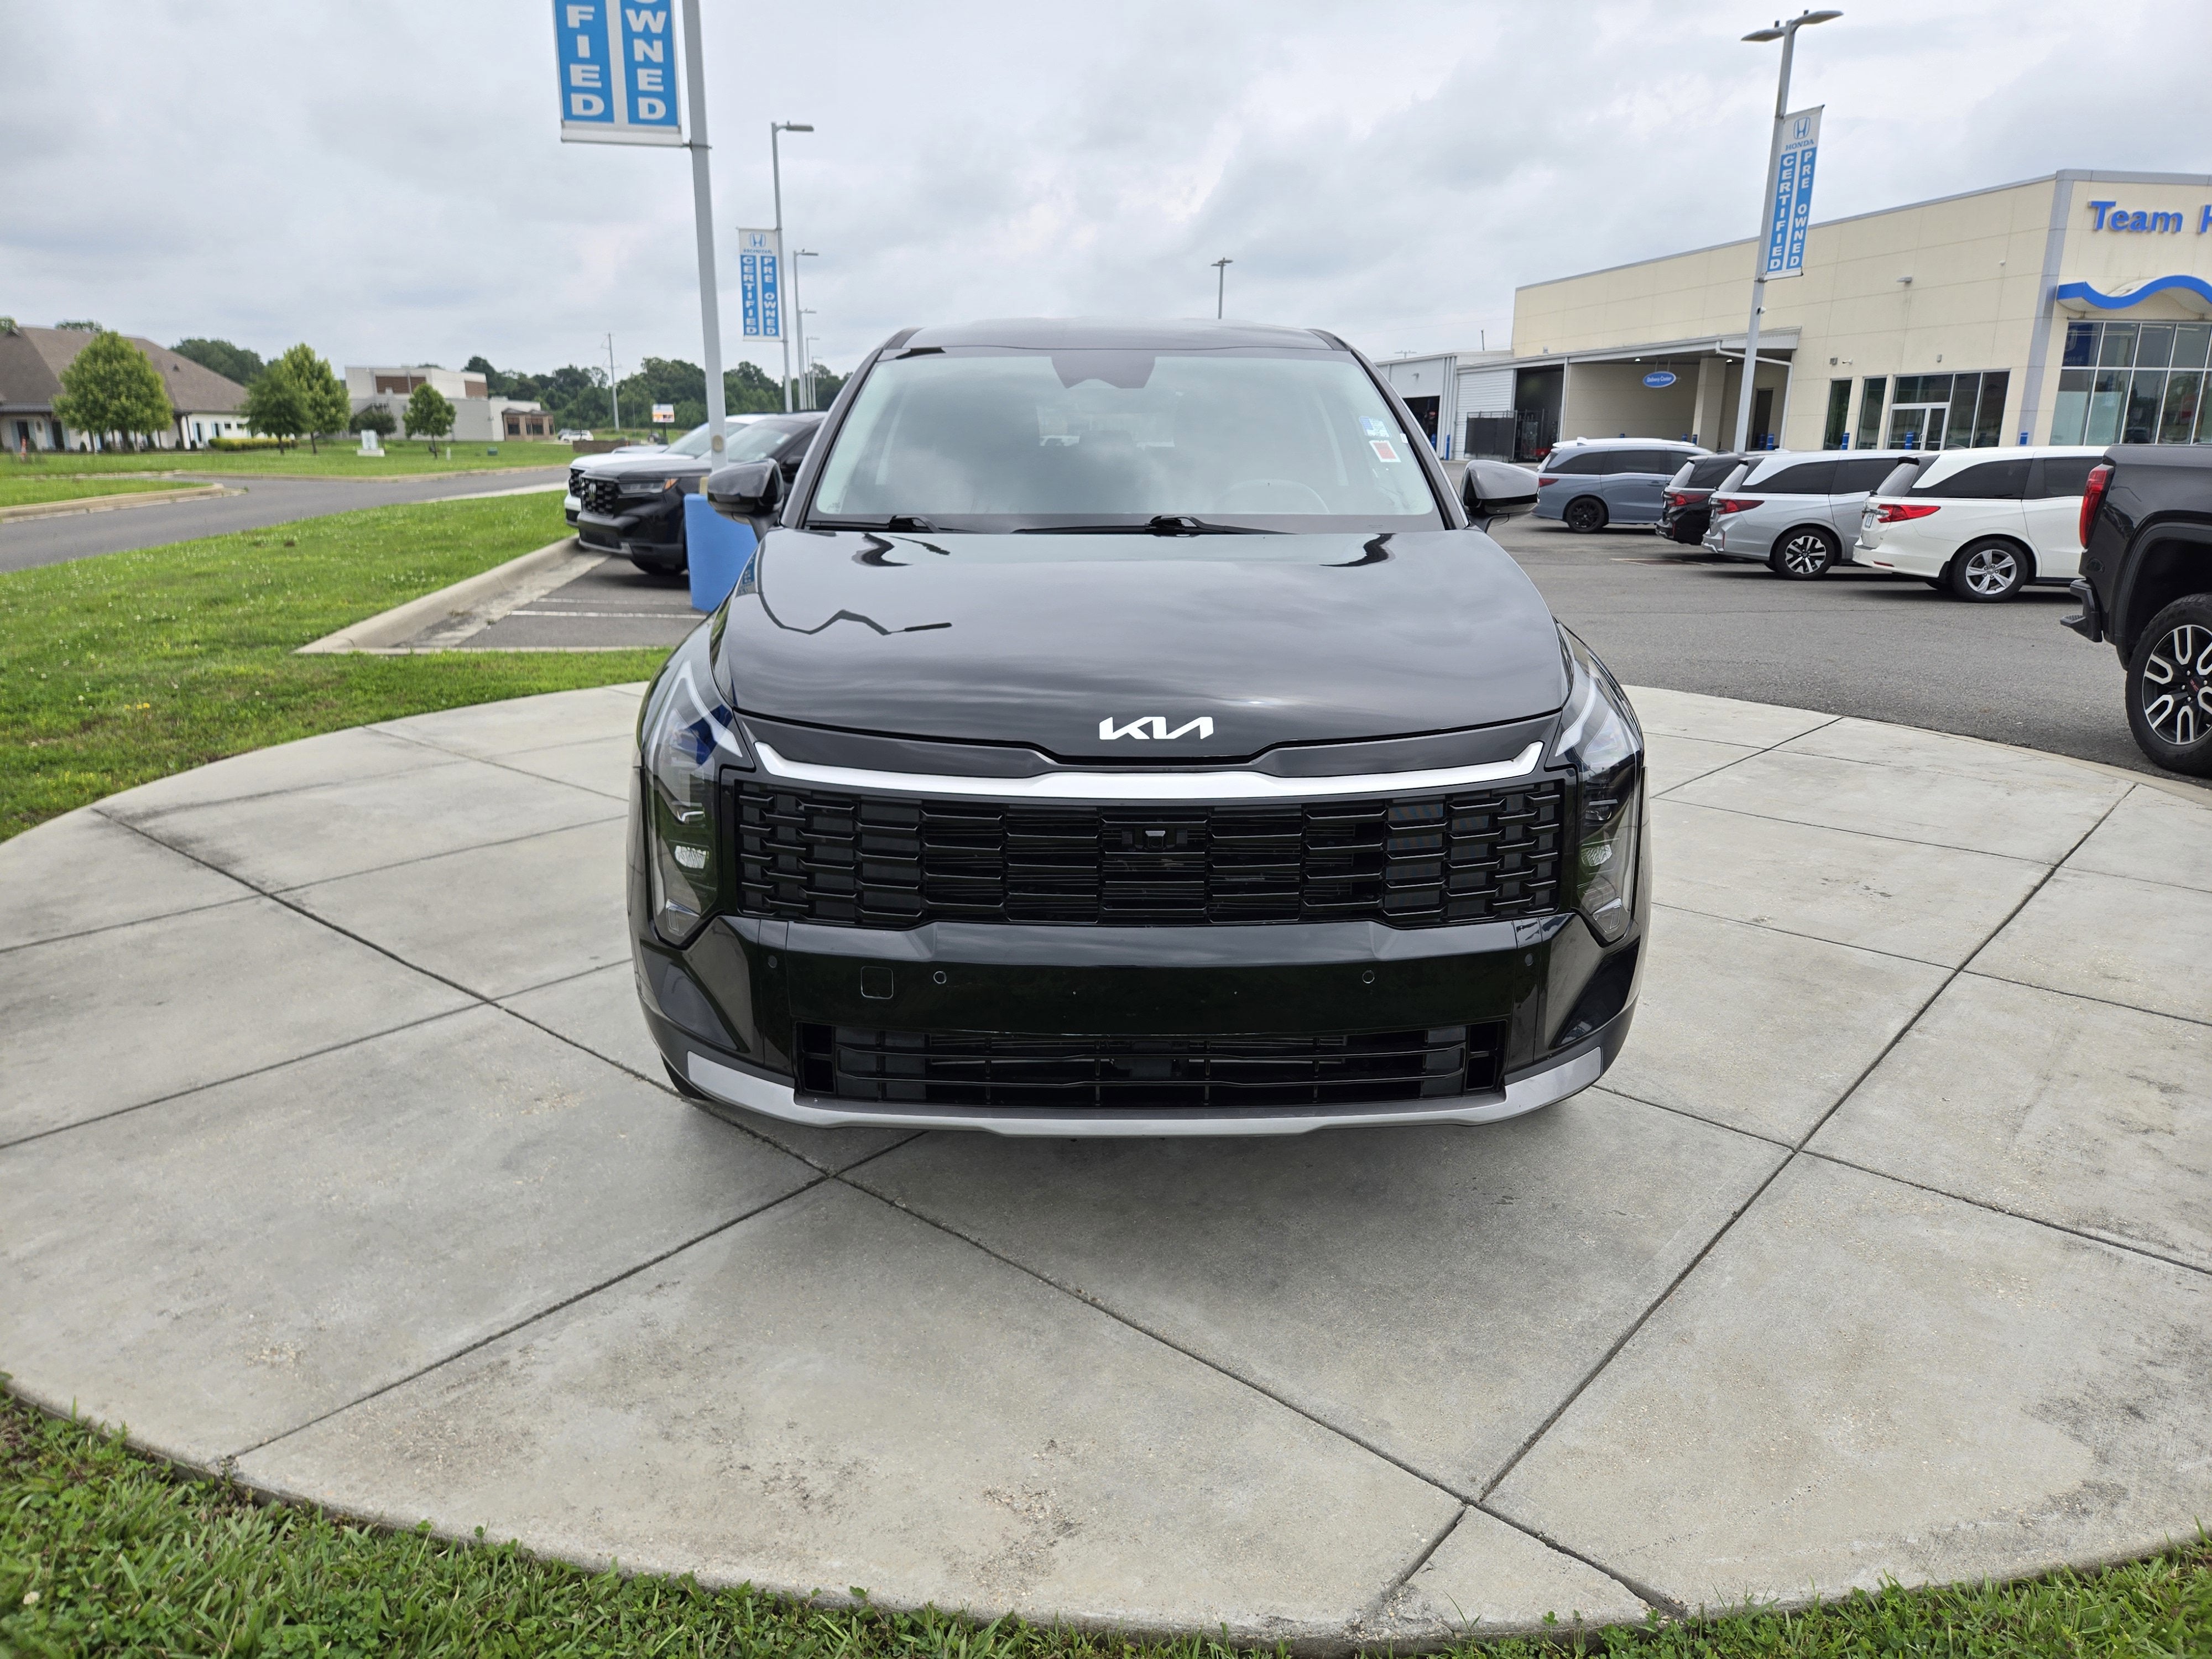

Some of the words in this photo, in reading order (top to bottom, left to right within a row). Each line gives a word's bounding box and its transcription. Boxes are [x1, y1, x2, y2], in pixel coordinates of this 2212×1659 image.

[566, 4, 605, 117] FIED
[625, 0, 667, 120] WNED
[1785, 139, 1814, 151] HONDA
[1801, 151, 1813, 189] PRE
[1769, 155, 1794, 270] CERTIFIED
[1789, 203, 1807, 267] OWNED
[2089, 200, 2184, 232] Team
[742, 257, 757, 334] CERTIFIED
[763, 257, 773, 283] PRE
[763, 292, 777, 335] OWNED
